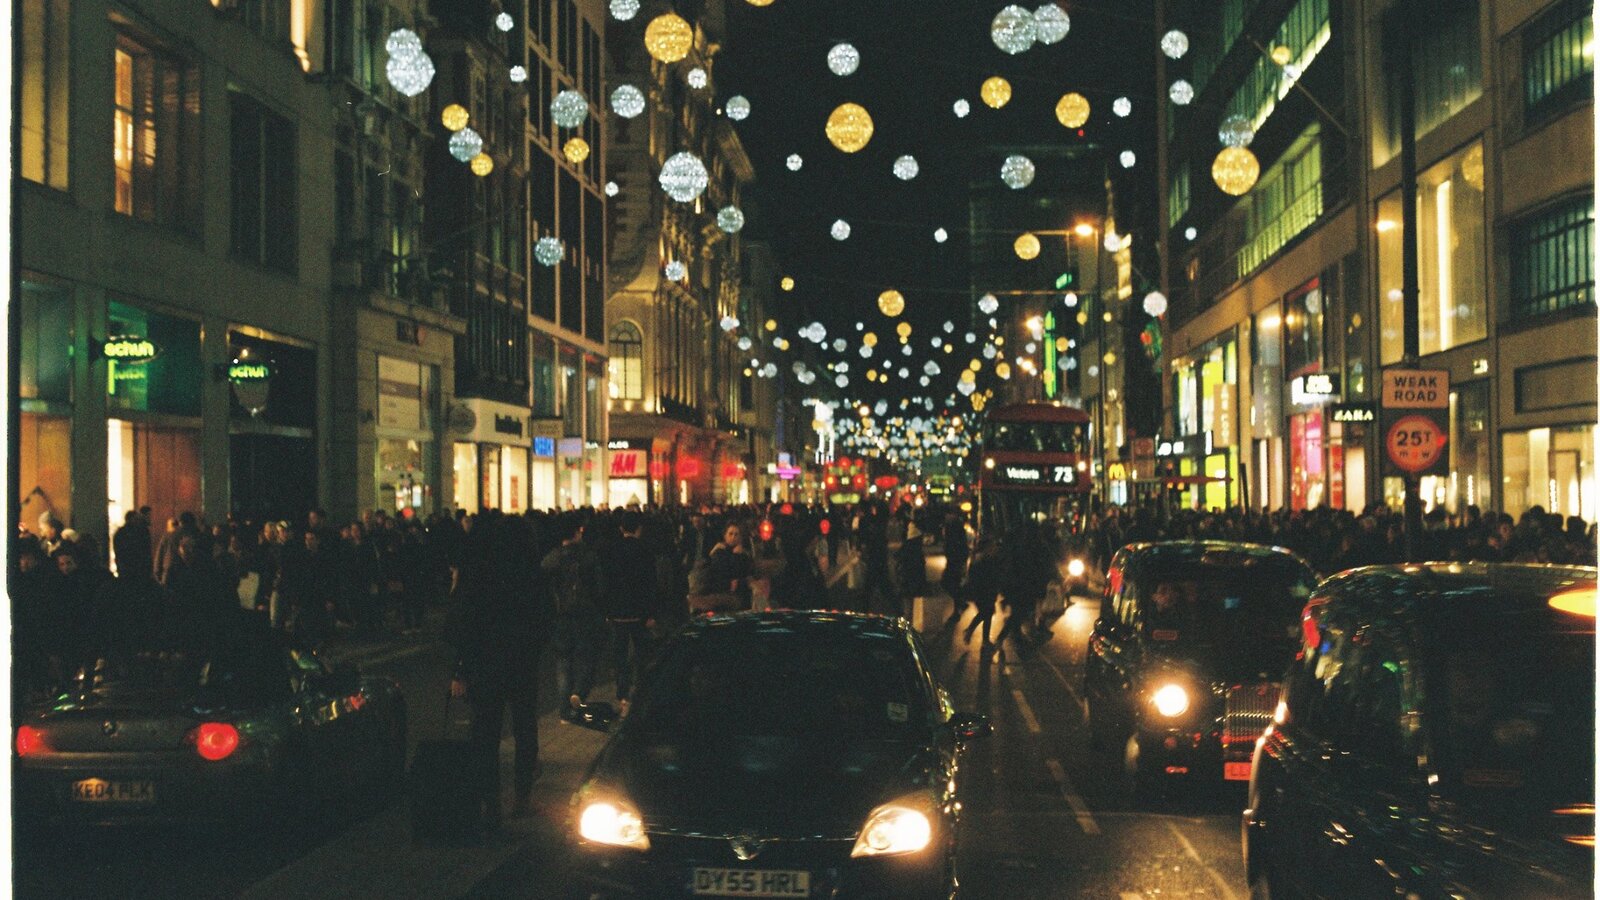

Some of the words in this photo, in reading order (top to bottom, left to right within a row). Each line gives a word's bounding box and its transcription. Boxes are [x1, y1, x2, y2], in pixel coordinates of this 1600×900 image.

[104, 341, 155, 356] schuh
[1394, 376, 1437, 388] WEAK
[1394, 391, 1437, 403] ROAD
[1054, 466, 1073, 482] 73
[696, 869, 756, 892] DY55
[761, 872, 805, 894] HRL
